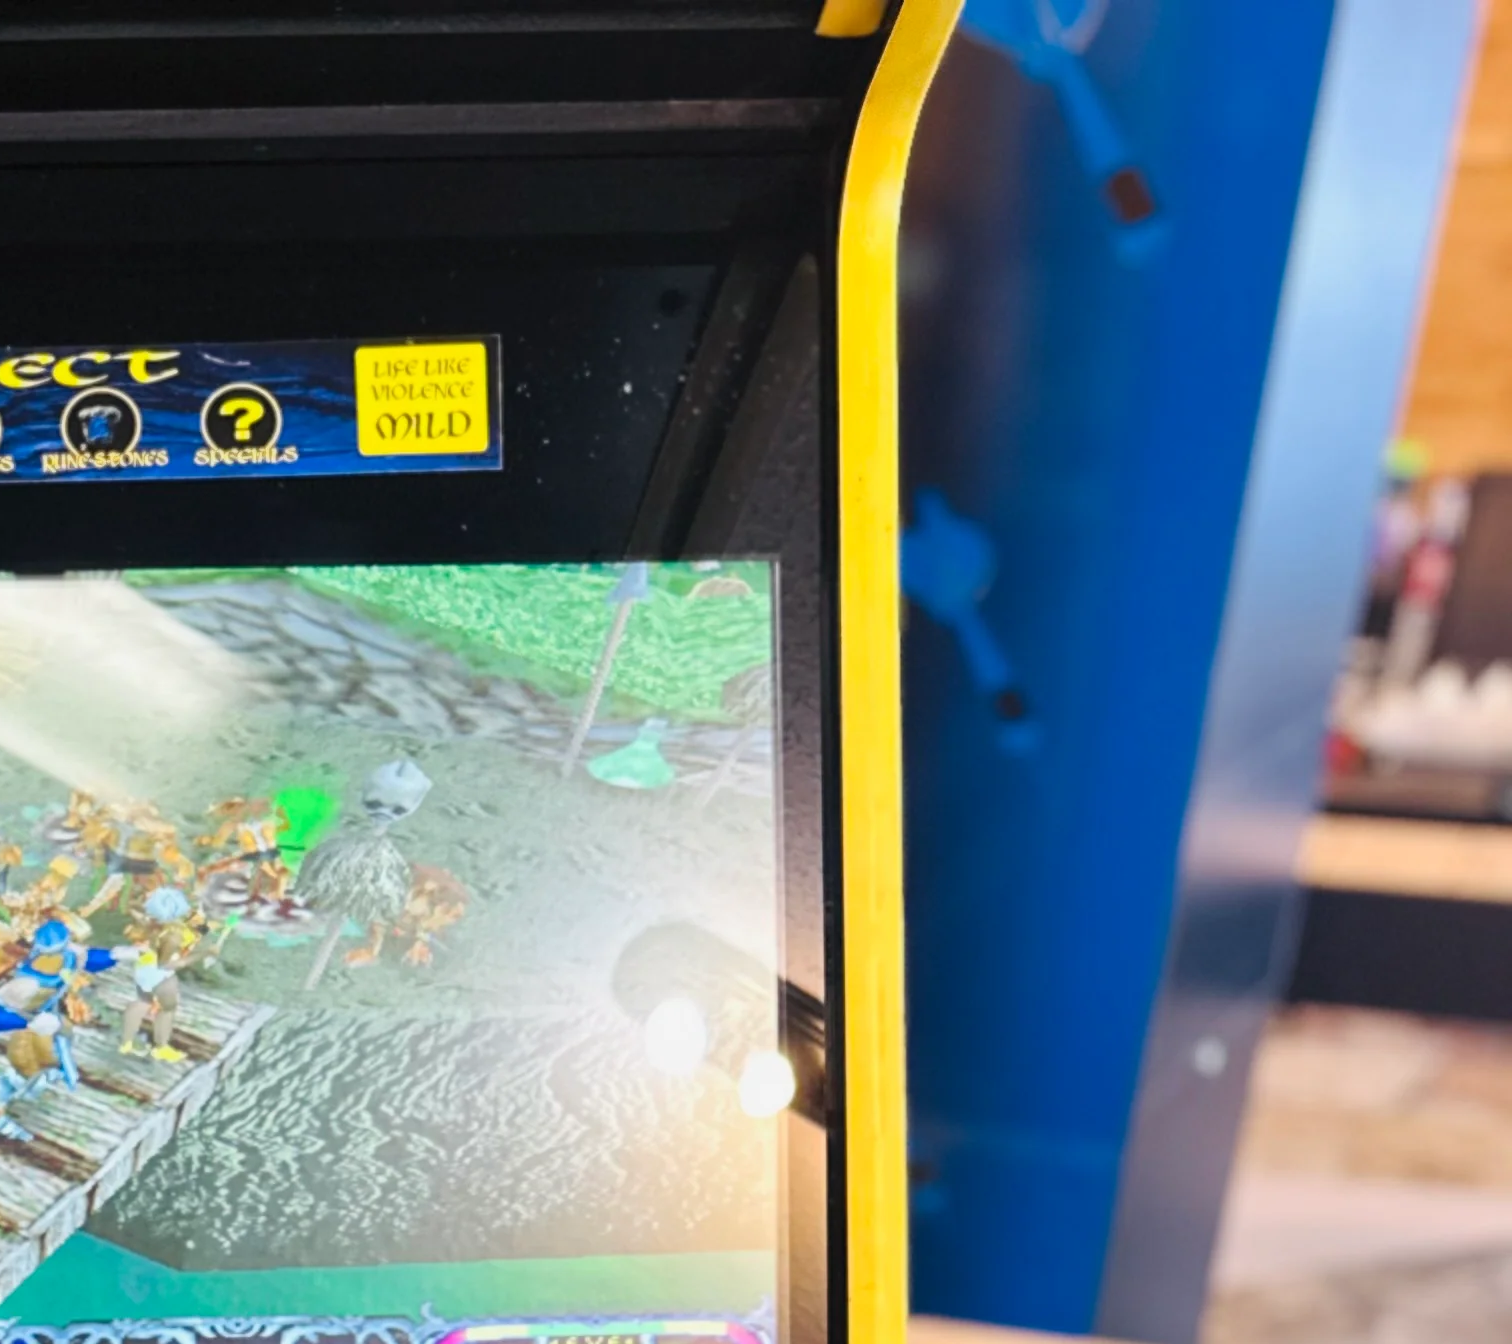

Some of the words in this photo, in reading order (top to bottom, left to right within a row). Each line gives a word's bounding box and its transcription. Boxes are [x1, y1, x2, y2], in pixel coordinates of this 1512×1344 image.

[372, 359, 418, 379] LIFE
[423, 356, 472, 377] LIKE
[370, 381, 474, 401] VIOLENCE
[375, 409, 473, 440] MILD
[193, 446, 300, 468] SPECIALS
